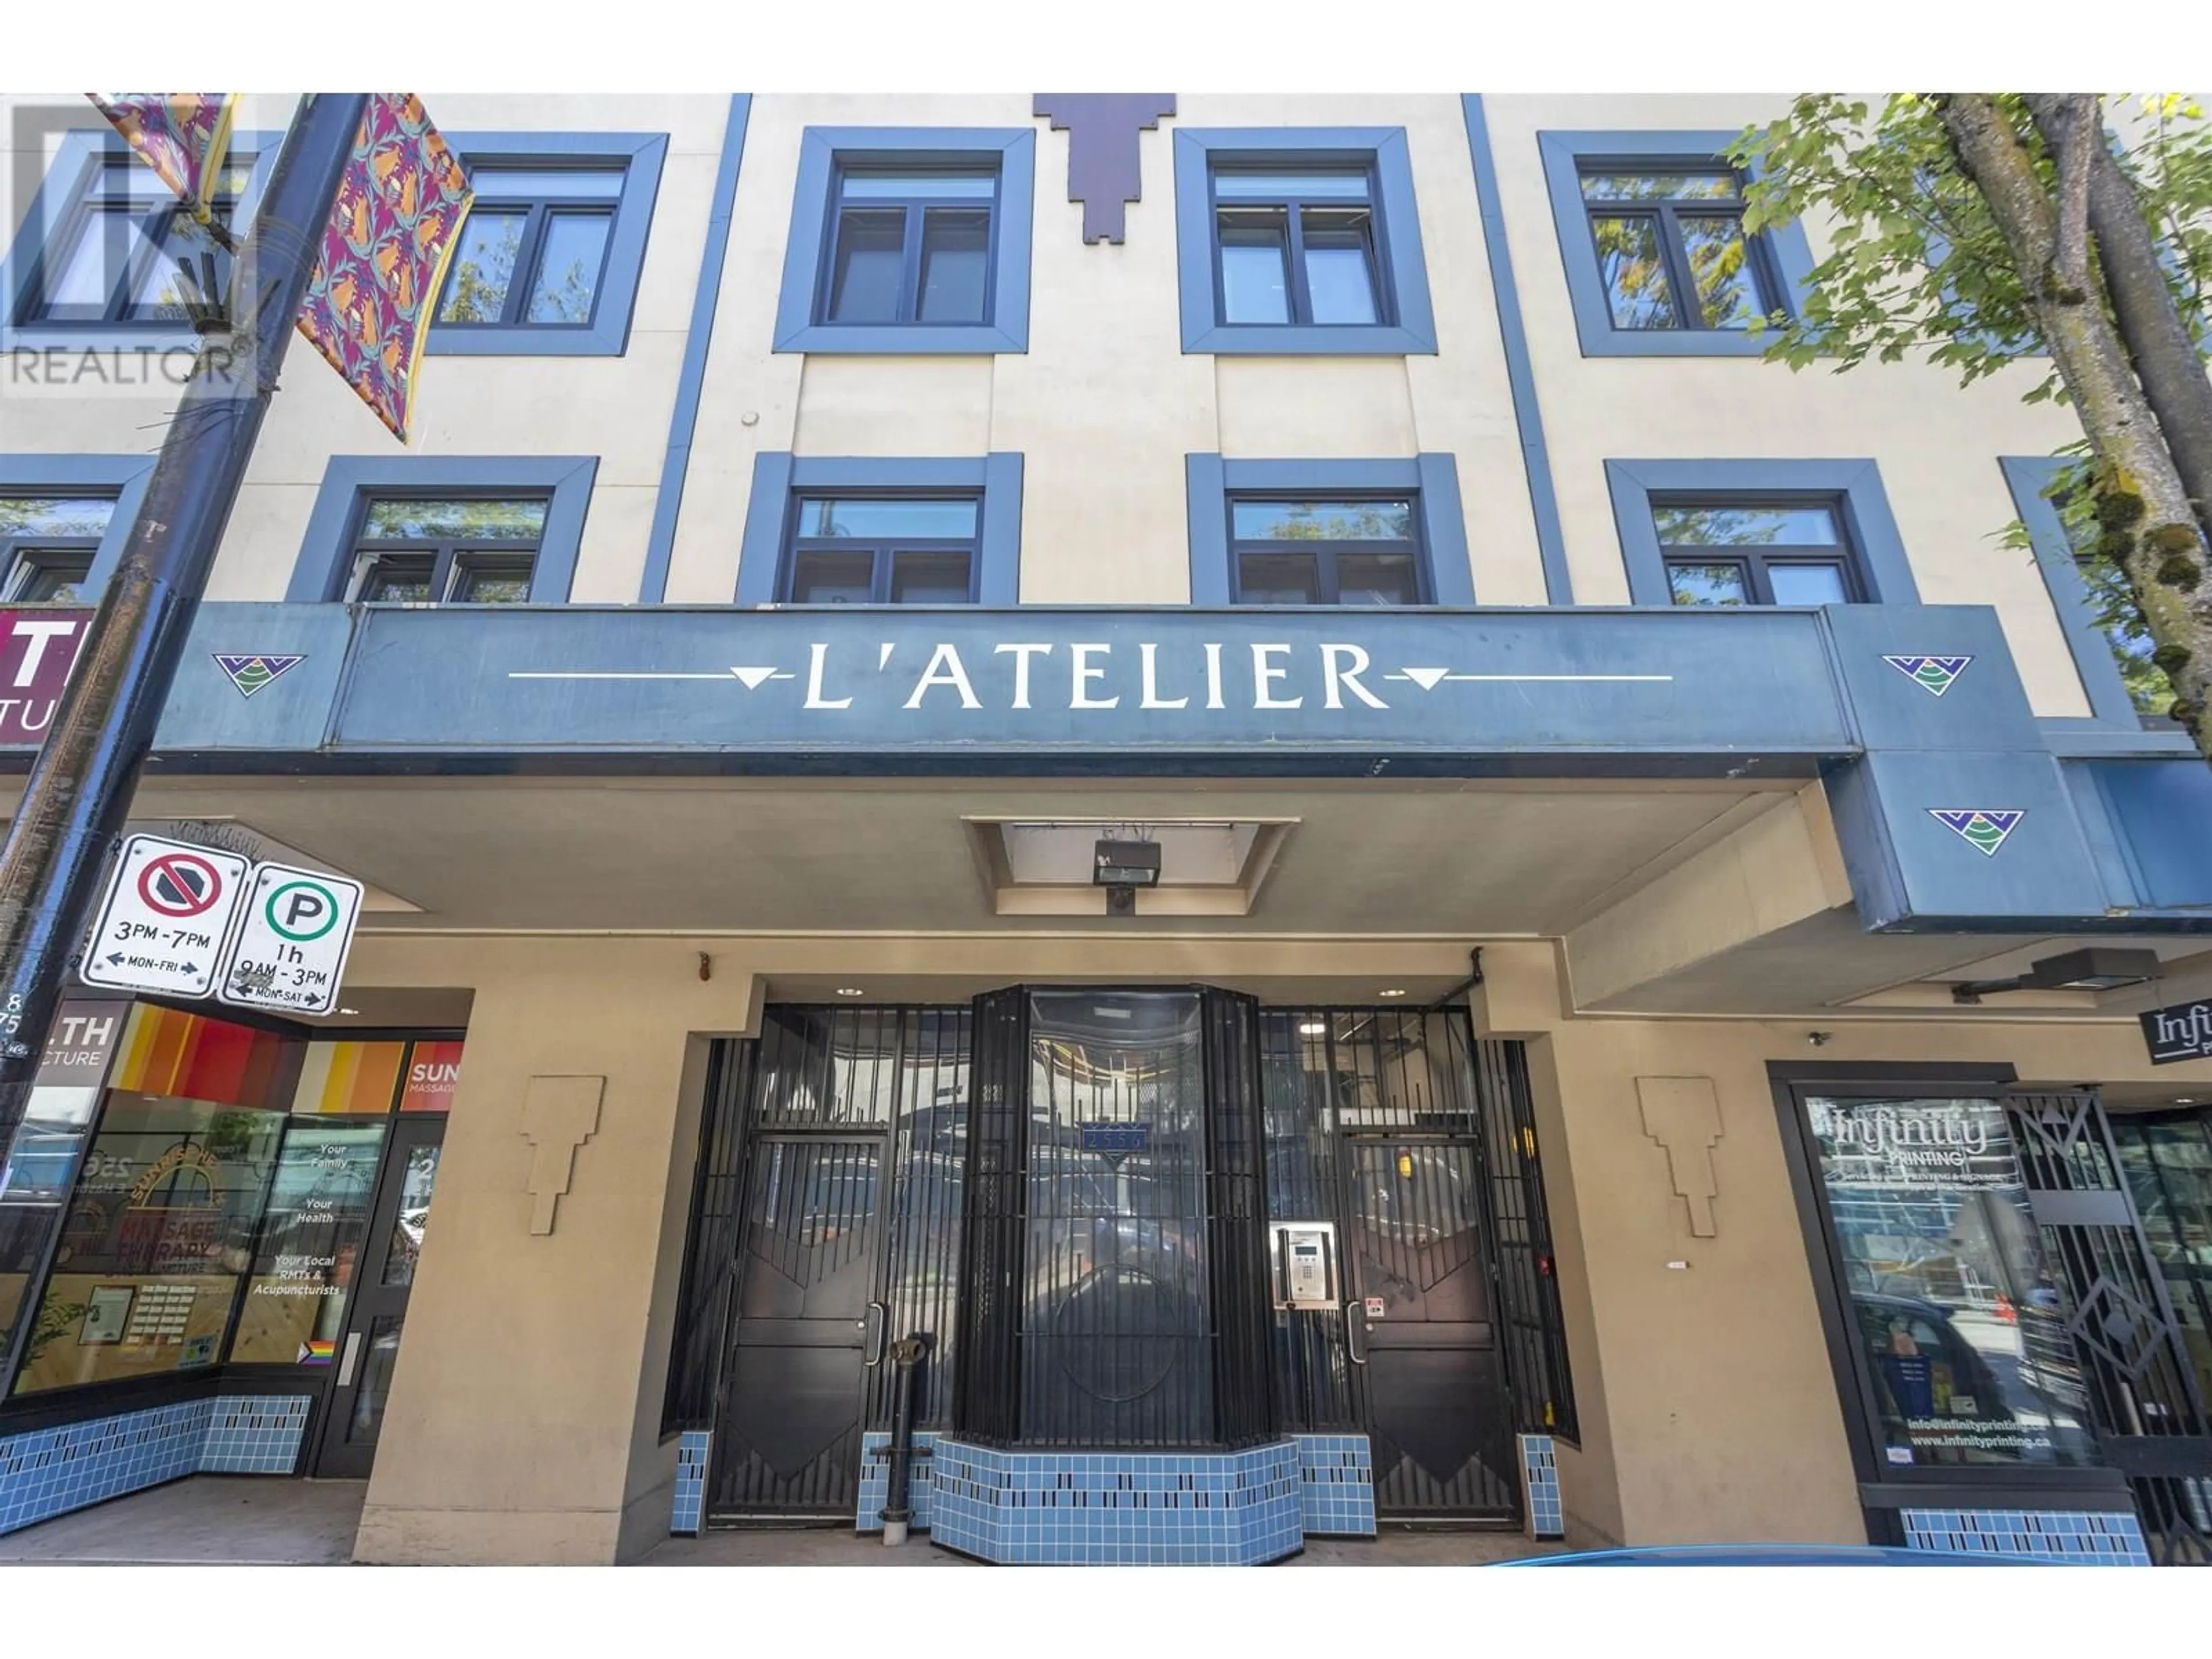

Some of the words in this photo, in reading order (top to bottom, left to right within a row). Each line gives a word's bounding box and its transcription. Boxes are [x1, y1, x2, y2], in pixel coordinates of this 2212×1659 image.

[802, 643, 1390, 709] L'ATELIER
[127, 955, 179, 972] MON-FRI
[1832, 1106, 1987, 1154] Infinity
[320, 1144, 347, 1154] Your
[310, 1158, 349, 1170] Family
[1888, 1151, 1964, 1166] PRINTING
[305, 1199, 333, 1209] Your
[297, 1213, 334, 1224] Health
[275, 1255, 302, 1266] Your
[279, 1270, 311, 1281] RMTs
[253, 1284, 340, 1297] Acupuncturists
